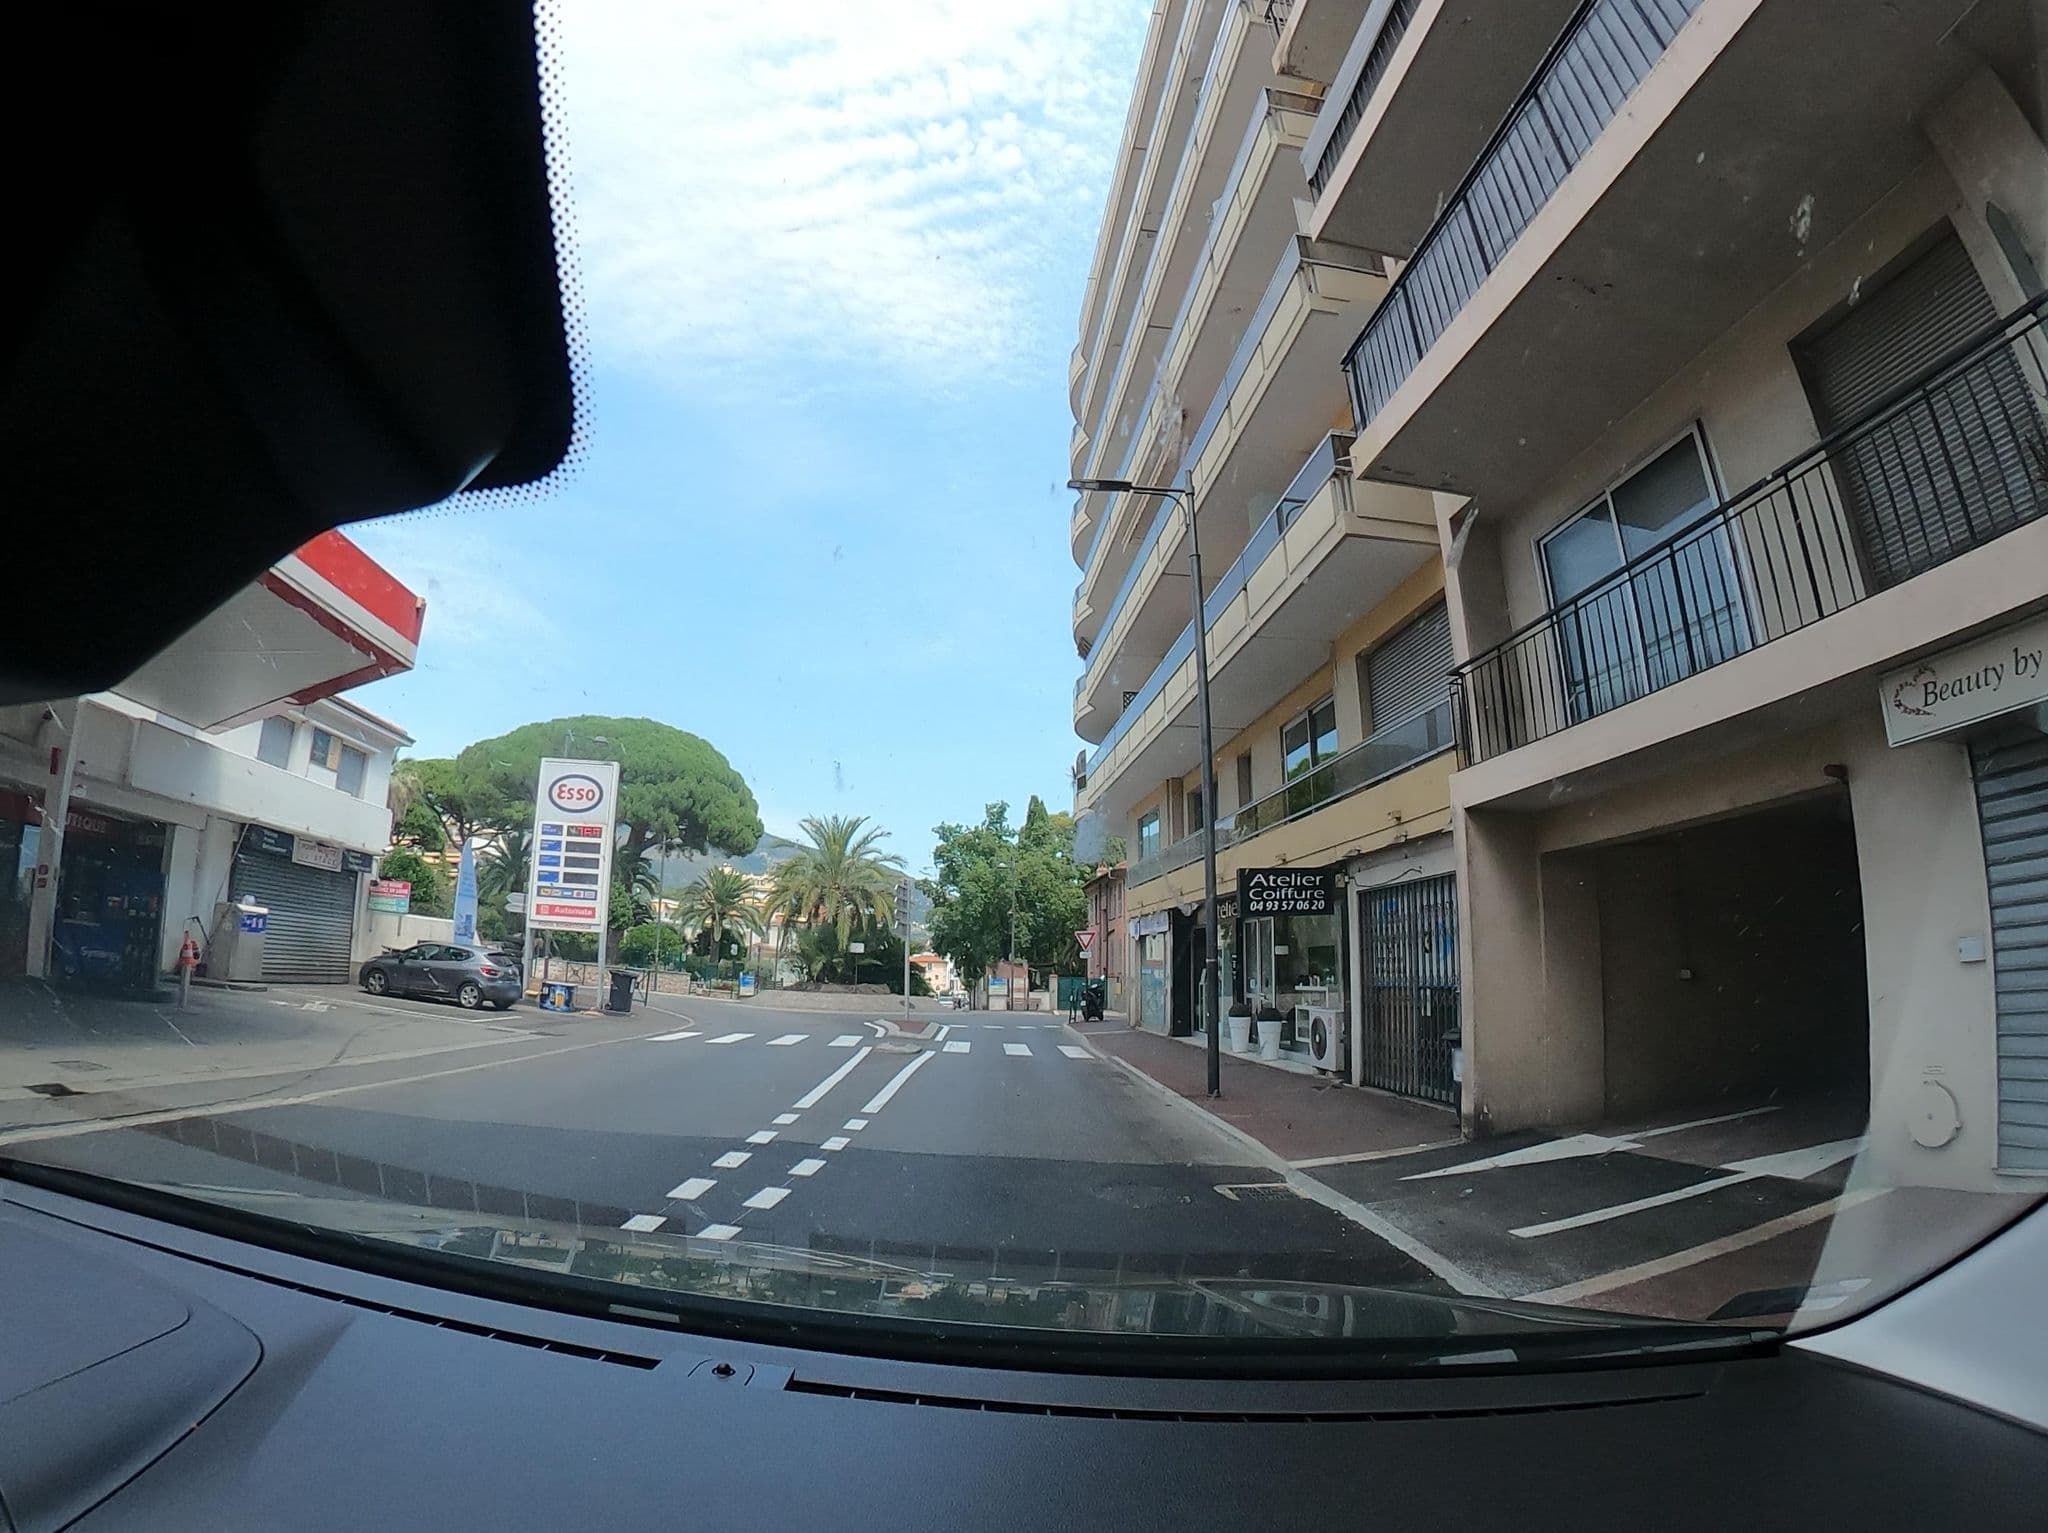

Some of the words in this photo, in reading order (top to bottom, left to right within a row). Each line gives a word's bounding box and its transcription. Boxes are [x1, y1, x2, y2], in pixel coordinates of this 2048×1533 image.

[1922, 663, 2005, 708] Beauty
[2012, 647, 2043, 679] by
[557, 783, 596, 802] Esso
[1249, 872, 1324, 887] Atelier
[1249, 888, 1325, 900] Coiffure
[1249, 901, 1264, 912] 04
[1265, 900, 1279, 911] 93
[1281, 900, 1295, 911] 57
[1296, 900, 1310, 911] 06
[1311, 900, 1325, 911] 20
